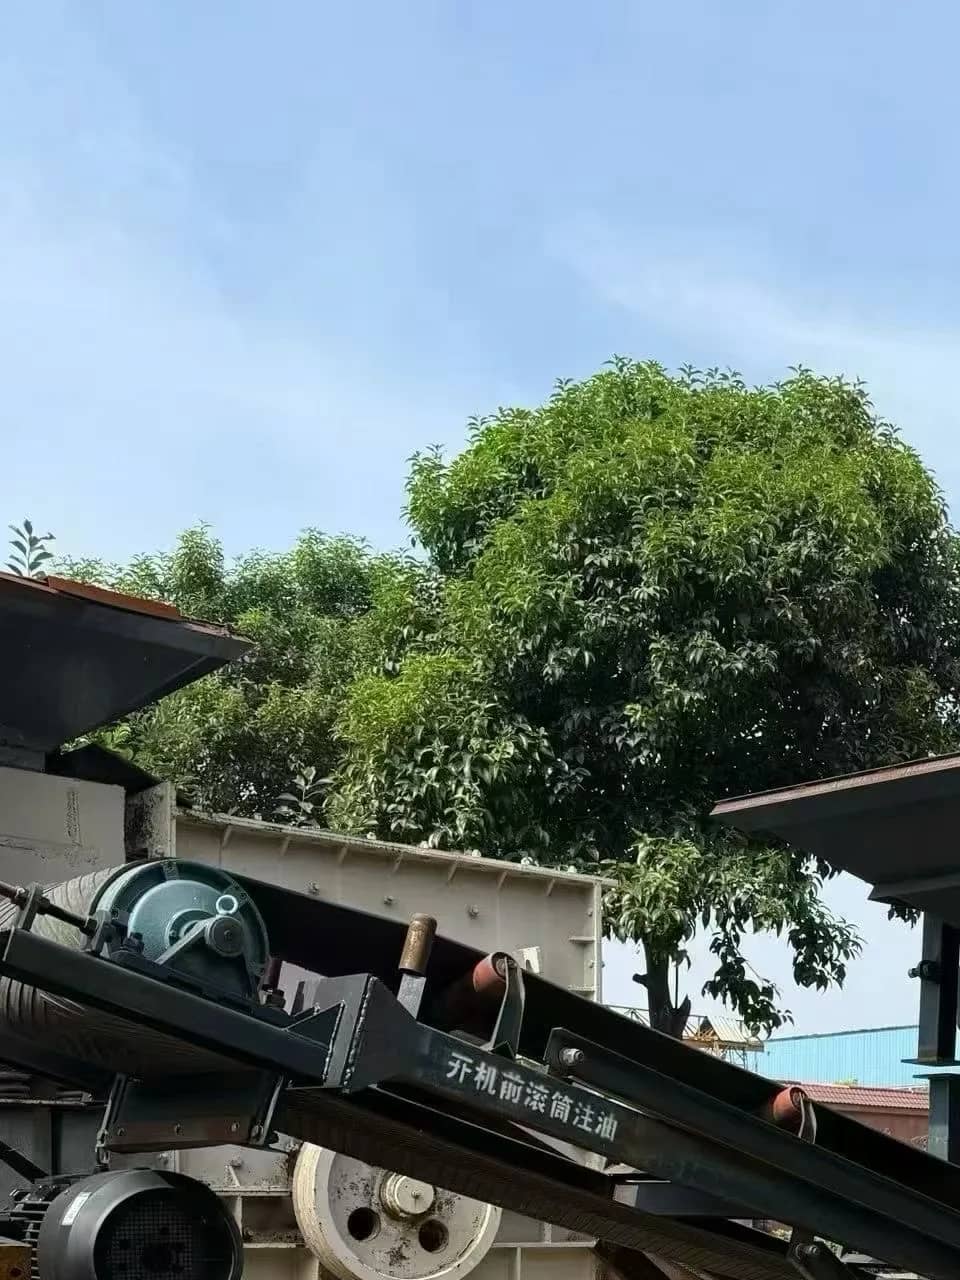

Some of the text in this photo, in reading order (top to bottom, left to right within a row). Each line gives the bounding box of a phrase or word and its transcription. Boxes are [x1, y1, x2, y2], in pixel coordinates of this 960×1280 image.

[446, 1052, 619, 1142] 开机前滚筒注油
